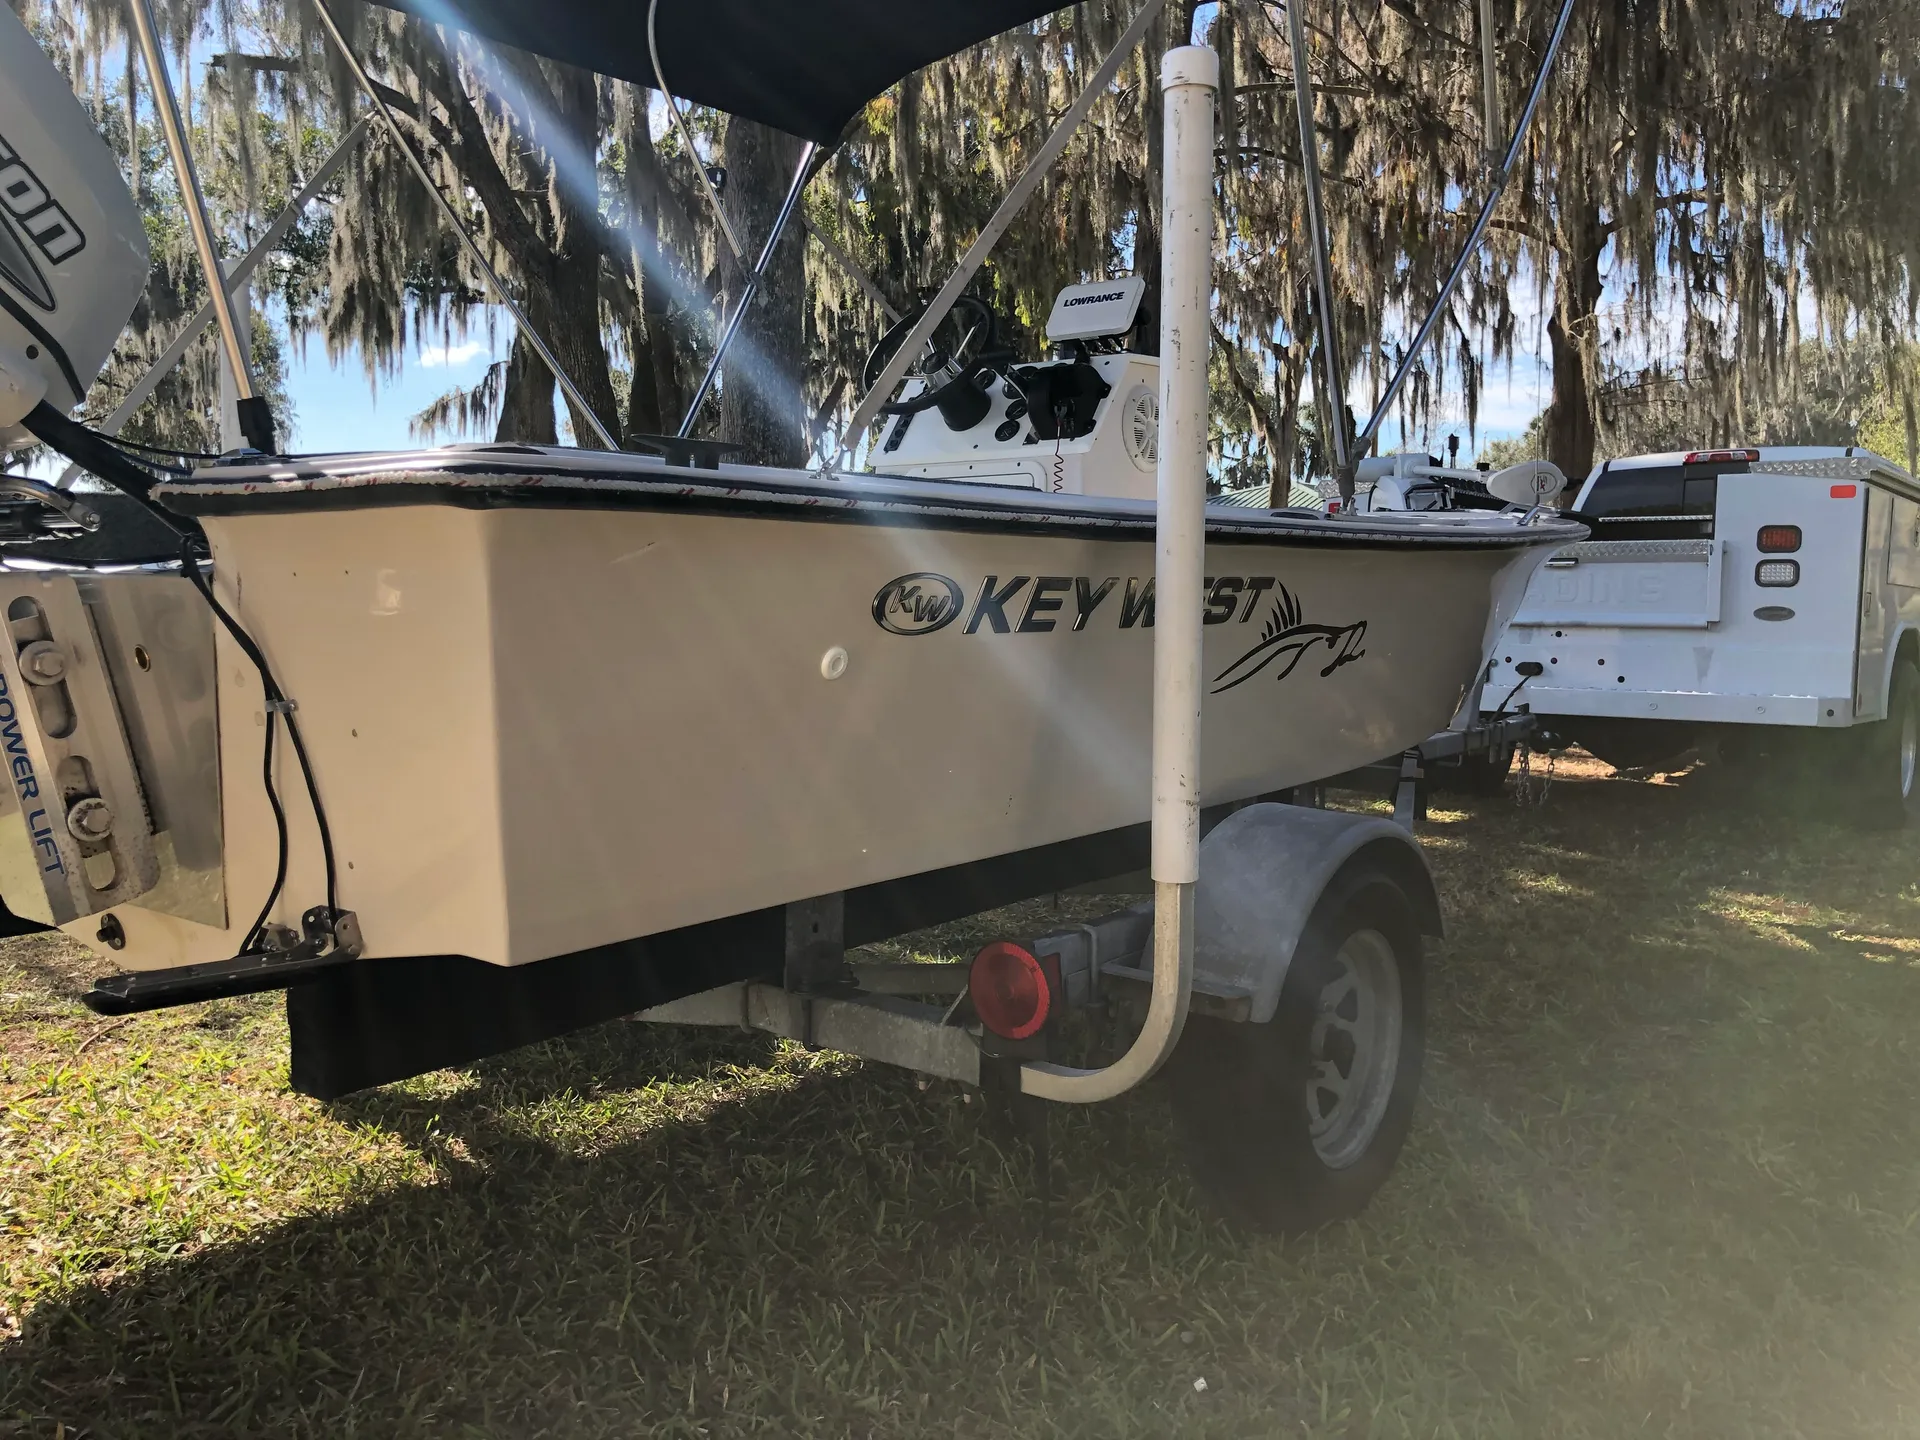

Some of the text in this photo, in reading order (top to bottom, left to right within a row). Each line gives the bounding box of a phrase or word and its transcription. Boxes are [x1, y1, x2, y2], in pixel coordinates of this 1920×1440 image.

[0, 134, 86, 265] on
[1063, 291, 1125, 307] LOWRANCE
[889, 585, 950, 622] KW
[962, 575, 1275, 635] KEY WST
[29, 808, 65, 875] LIFT
